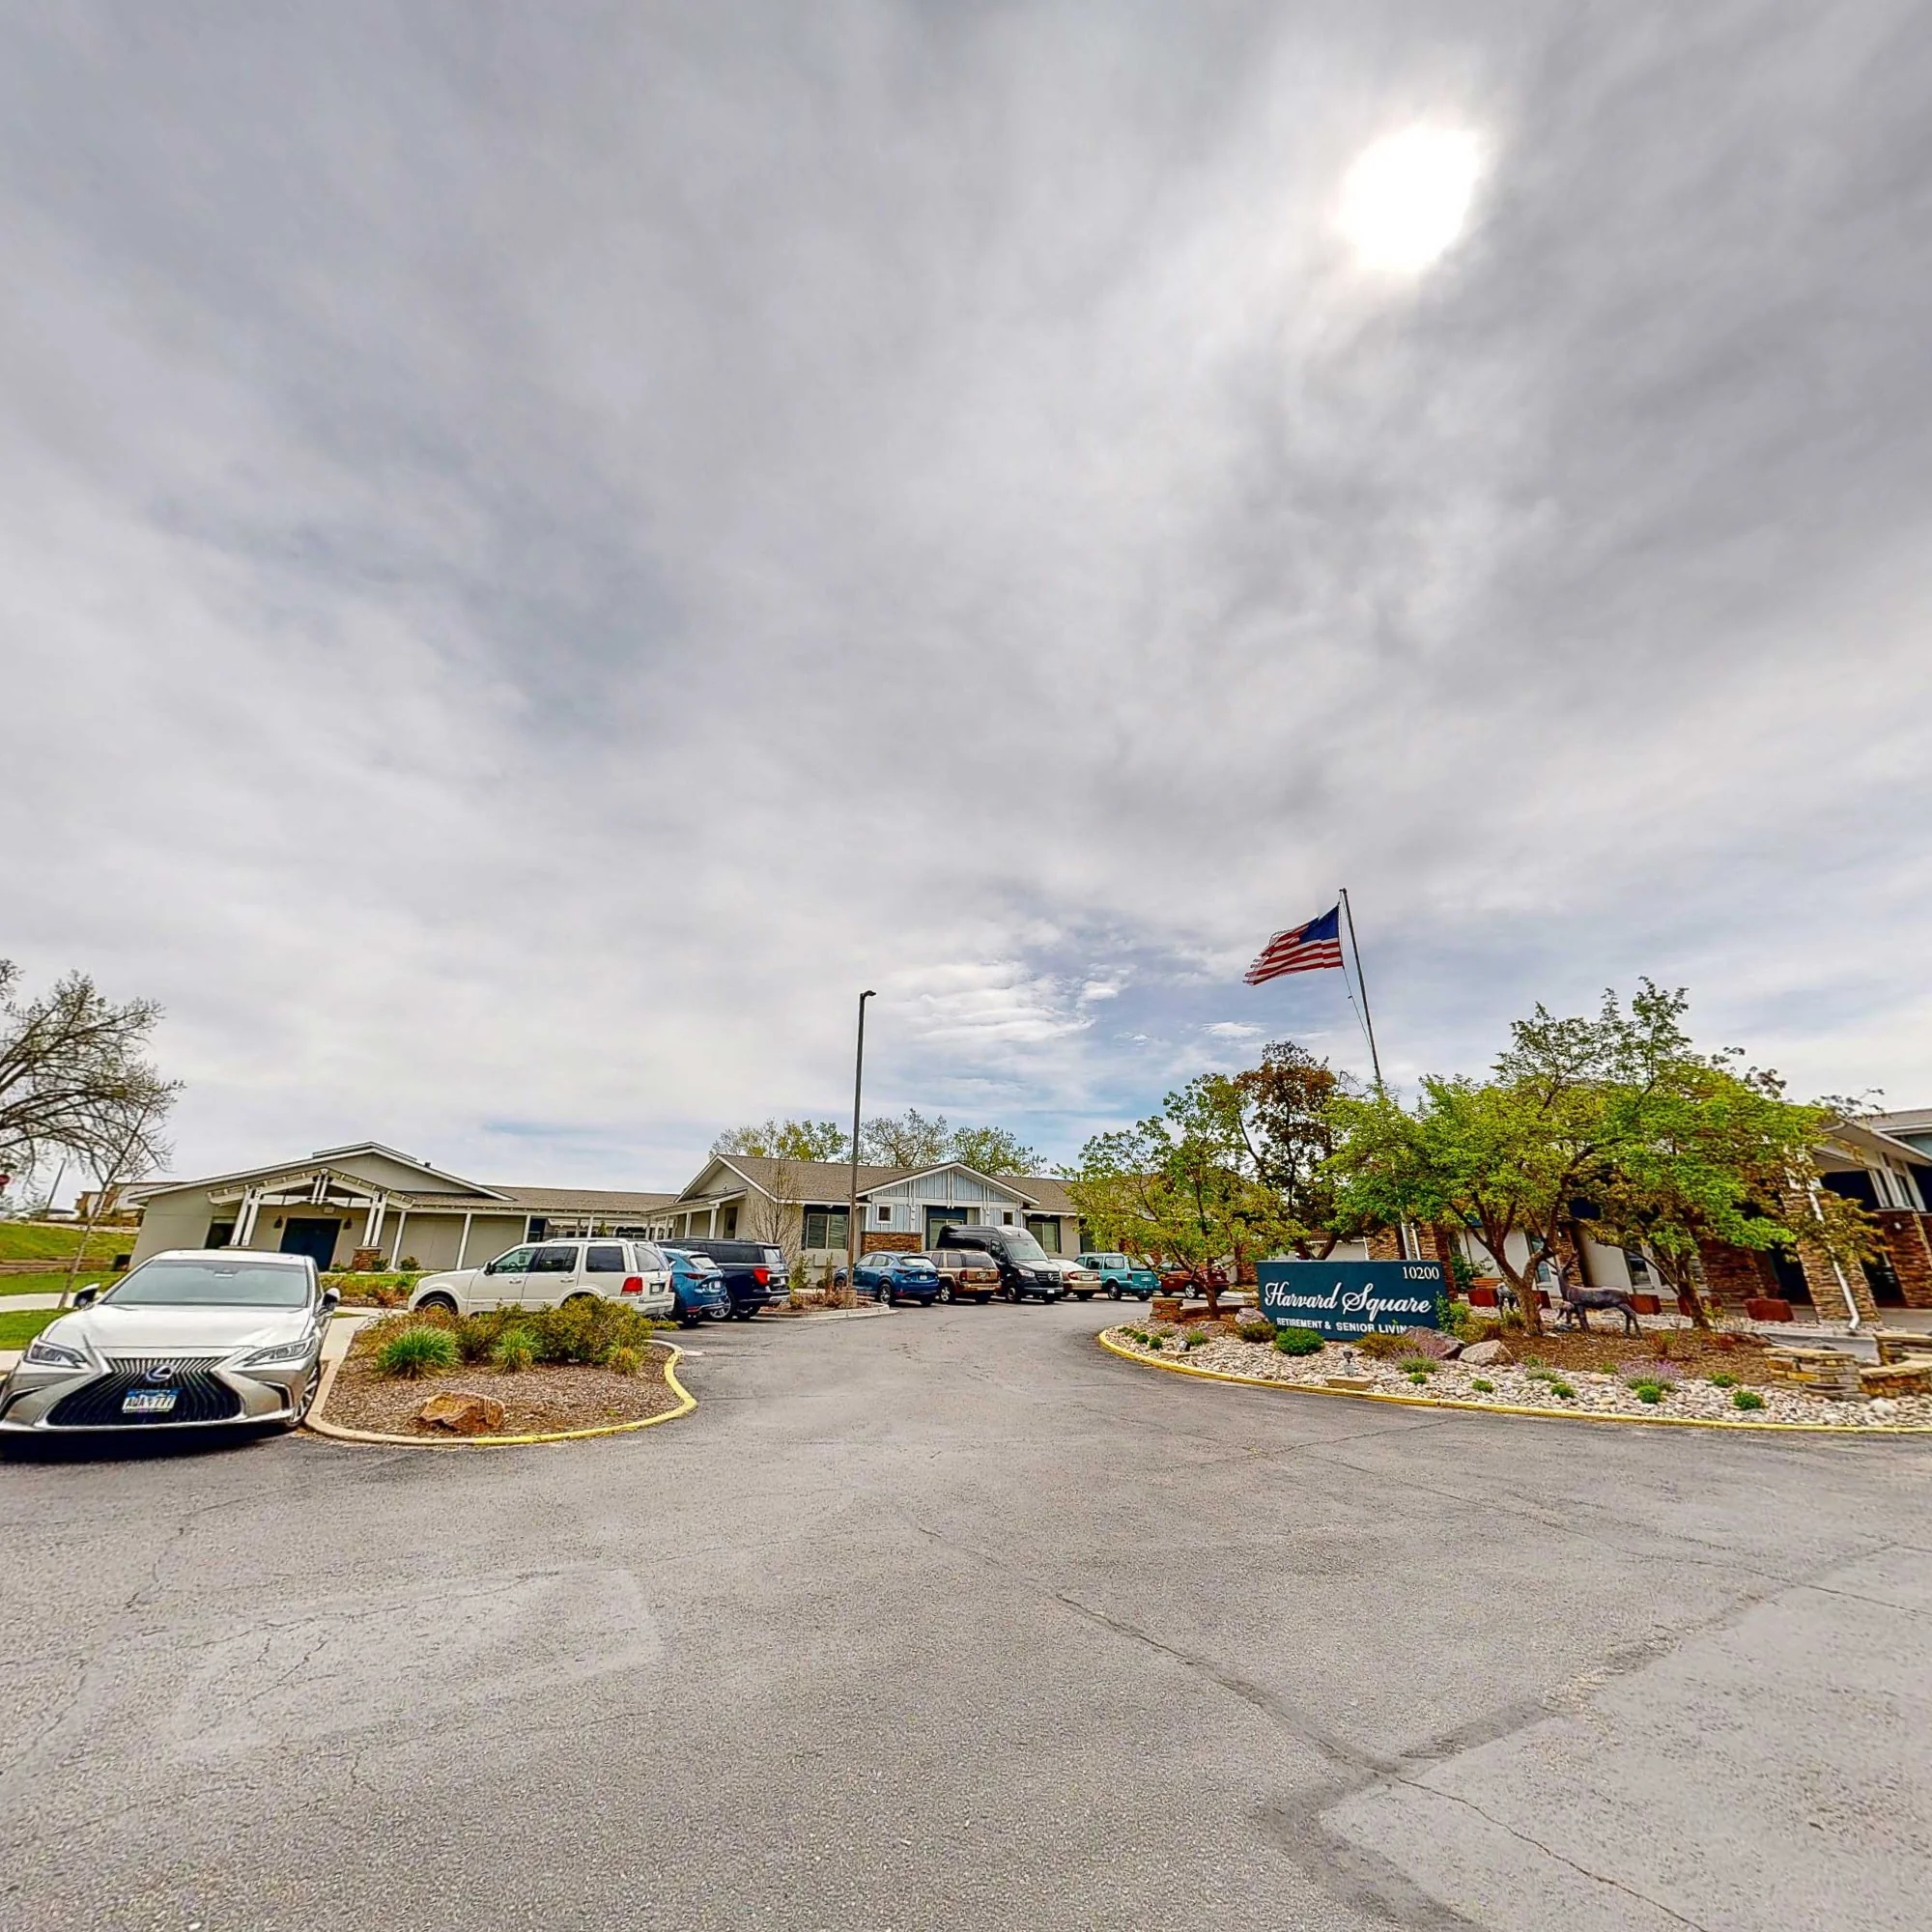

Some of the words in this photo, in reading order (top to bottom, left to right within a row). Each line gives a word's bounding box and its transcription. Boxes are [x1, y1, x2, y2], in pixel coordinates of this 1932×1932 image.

[1403, 1266, 1439, 1280] 10200
[1264, 1282, 1342, 1310] Harvard
[1342, 1283, 1432, 1321] Square
[1276, 1317, 1322, 1329] RETIREMENT
[1324, 1321, 1332, 1330] &
[1336, 1322, 1375, 1333] SENIOR
[1378, 1323, 1414, 1334] LIVIN
